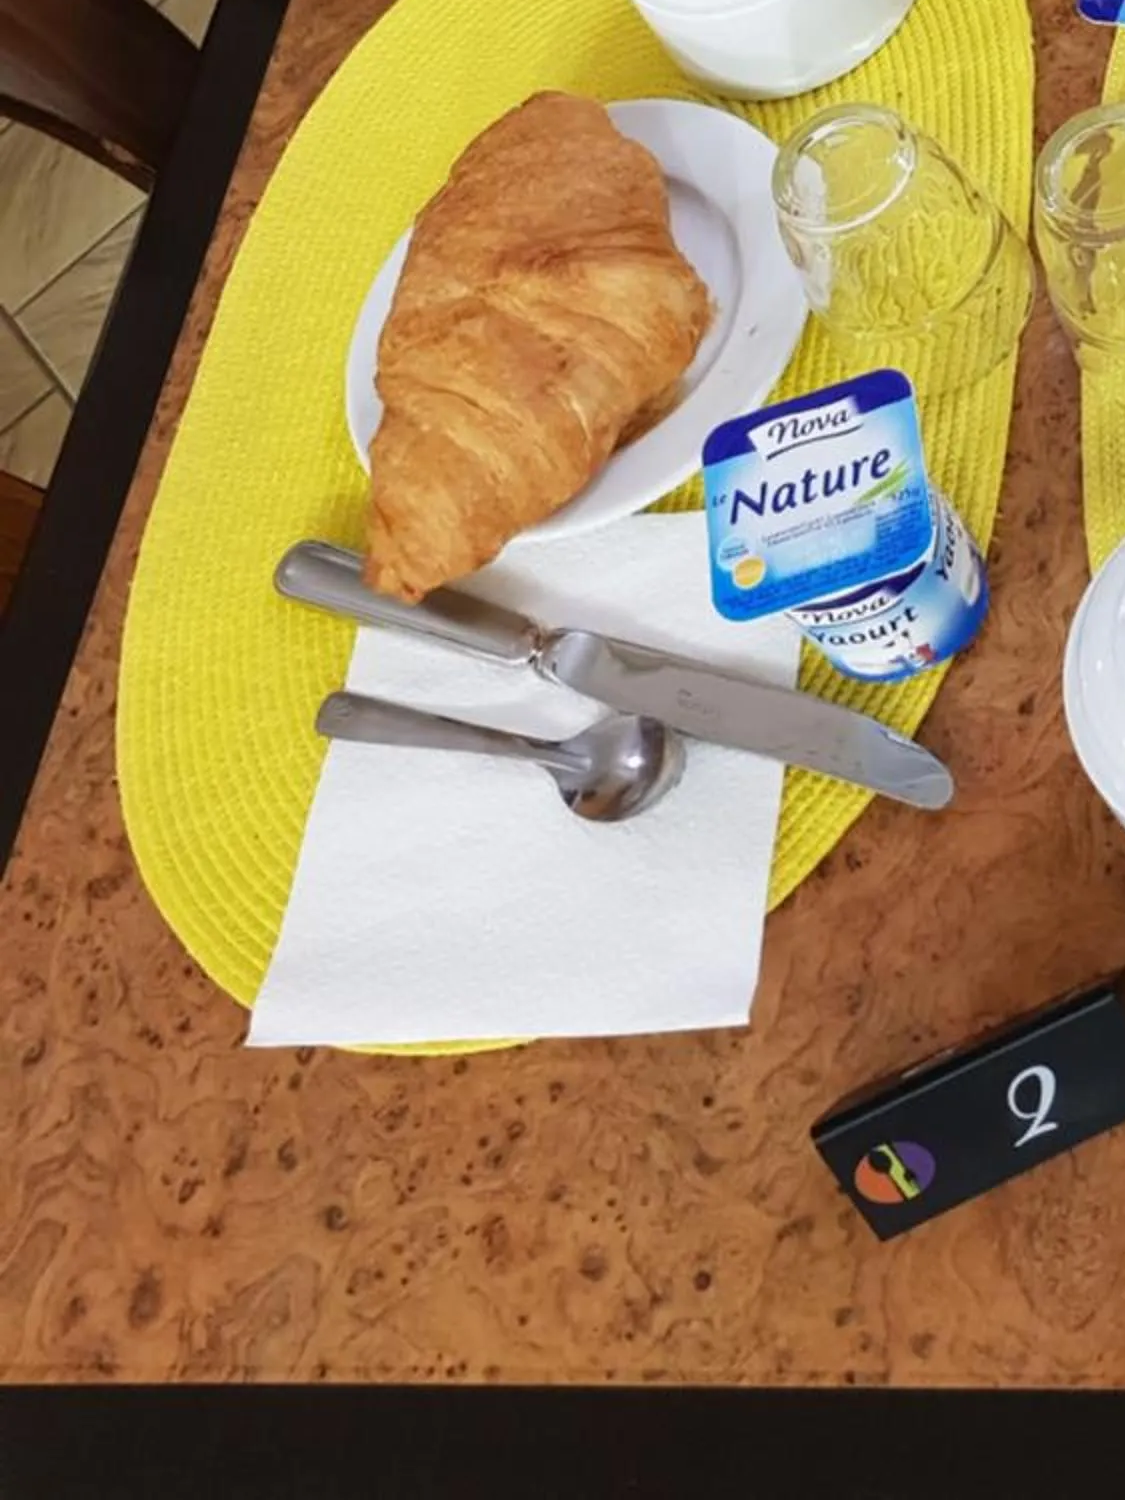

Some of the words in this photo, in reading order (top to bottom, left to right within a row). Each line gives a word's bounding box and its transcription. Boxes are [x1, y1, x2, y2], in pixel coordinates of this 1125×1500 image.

[768, 408, 850, 444] Nova
[729, 448, 891, 525] Nature
[1007, 1064, 1058, 1148] 2
